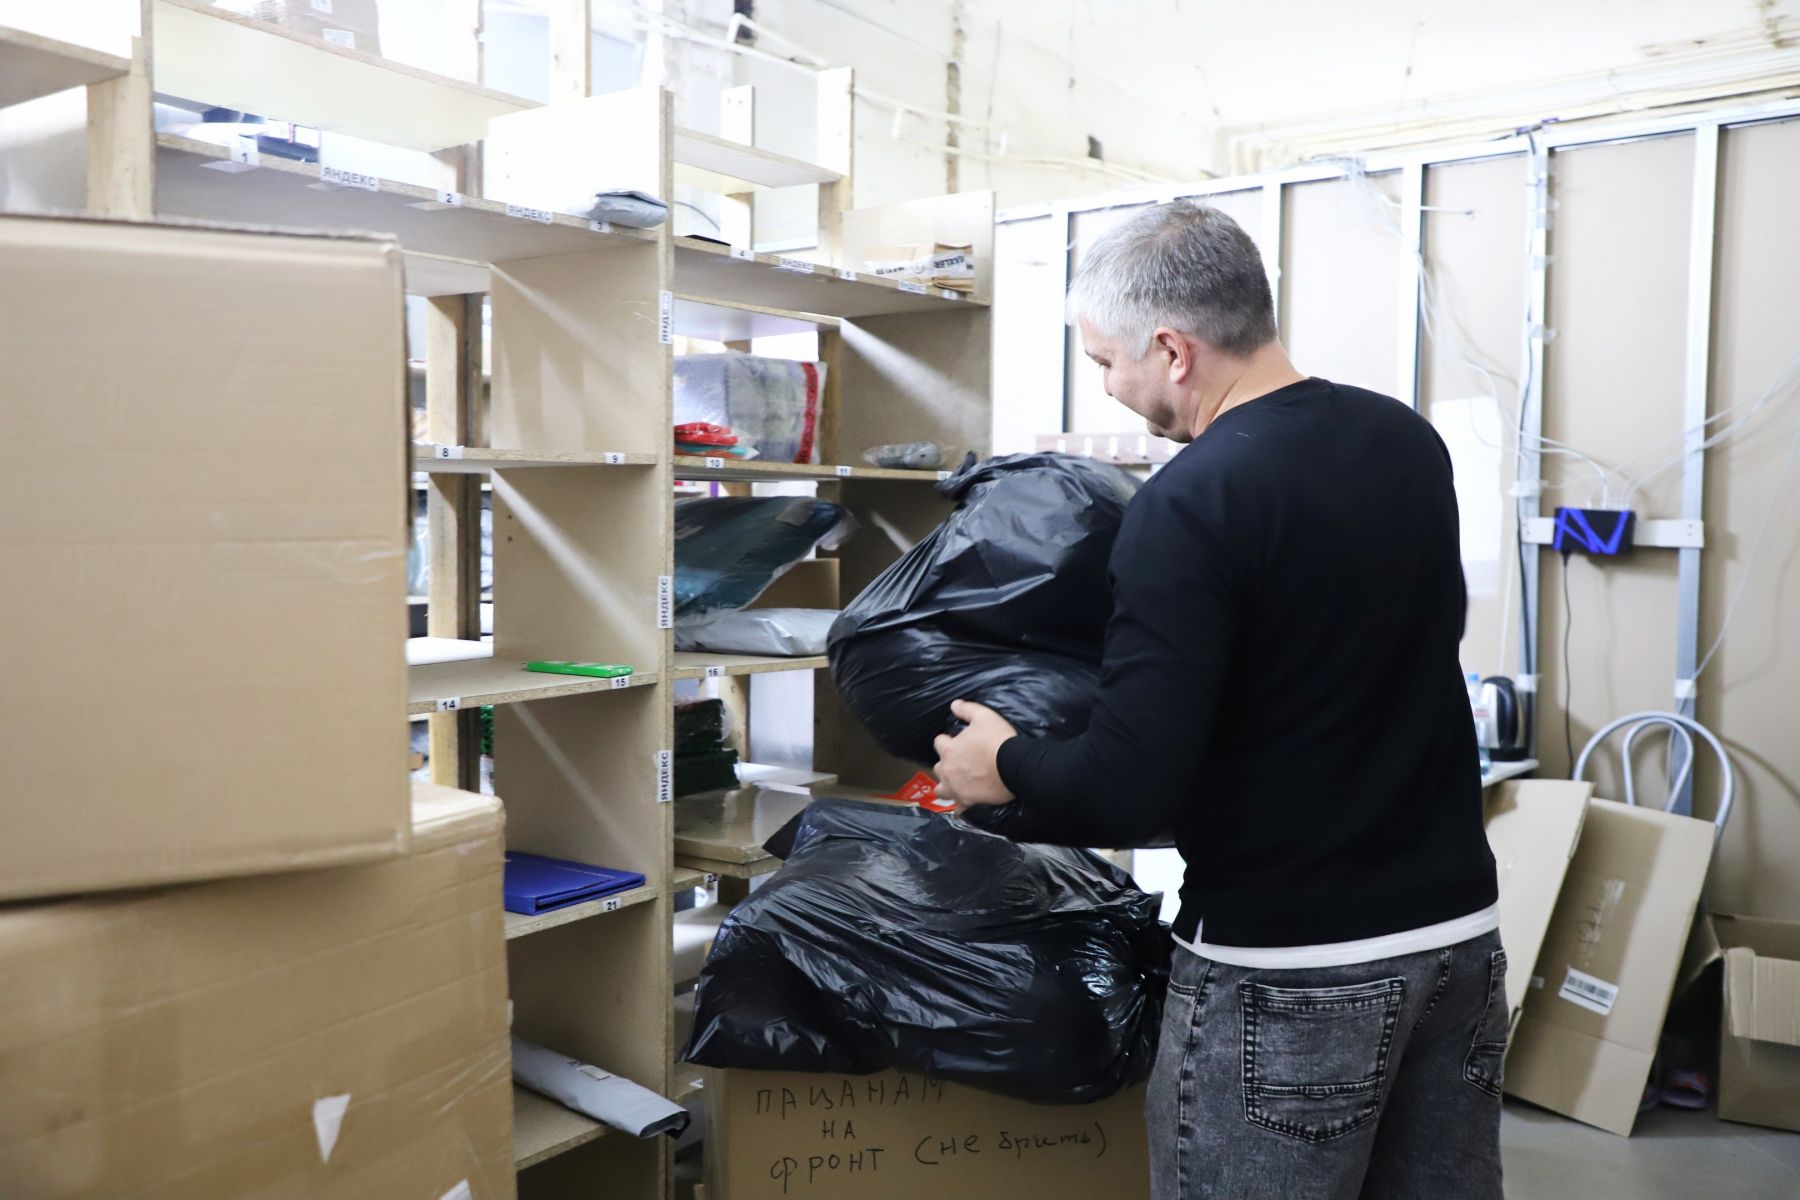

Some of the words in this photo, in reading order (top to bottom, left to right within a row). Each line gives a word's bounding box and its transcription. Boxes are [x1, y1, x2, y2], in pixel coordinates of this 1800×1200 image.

[241, 152, 249, 163] 1
[322, 166, 377, 188] ЯНДЕКС
[445, 193, 453, 204] 2
[507, 204, 552, 221] ЯНДЕКС
[442, 447, 449, 458] 8
[612, 454, 619, 464] 9
[709, 459, 721, 468] 10
[839, 467, 849, 475] 11
[660, 577, 670, 627] ЯНДЕКС
[708, 667, 719, 677] 16
[615, 677, 626, 688] 15
[442, 700, 456, 711] 14
[660, 751, 670, 801] ЯНДЕКС
[606, 900, 617, 911] 21
[756, 1074, 943, 1121] ПАЦАНАМ
[821, 1119, 857, 1140] НА
[770, 1148, 885, 1195] ФРОНТ
